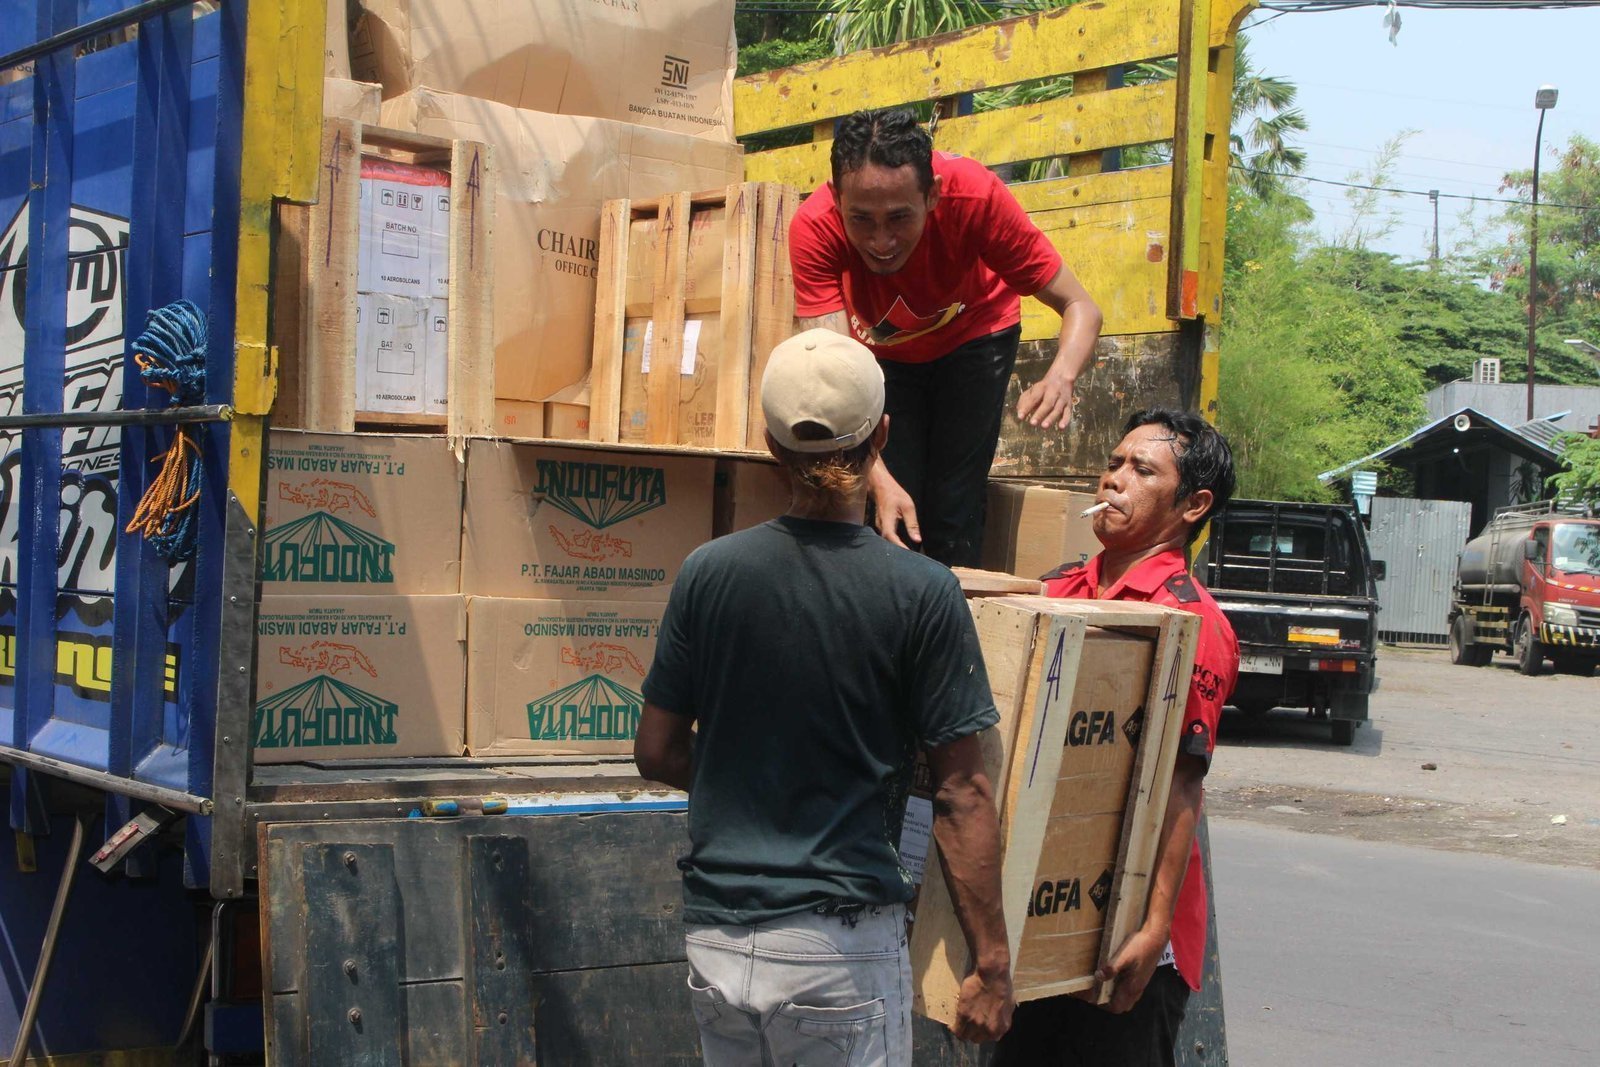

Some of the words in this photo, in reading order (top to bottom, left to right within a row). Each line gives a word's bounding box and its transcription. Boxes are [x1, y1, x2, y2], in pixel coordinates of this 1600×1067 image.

[661, 60, 690, 85] SNI
[628, 103, 657, 117] BANGGA
[657, 109, 687, 122] BUATAN
[385, 221, 406, 231] BATCH
[537, 228, 600, 262] CHAIR
[555, 259, 589, 278] OFFICE
[268, 455, 294, 470] MAS
[298, 457, 338, 472] ABADI
[341, 459, 380, 475] FAJAR
[384, 461, 405, 475] P.T.
[534, 459, 667, 504] INDOFUTA
[262, 543, 395, 583] INDOFUT
[521, 564, 541, 577] P.T.
[544, 565, 580, 578] FAJAR
[583, 566, 616, 580] ABADI
[618, 567, 666, 581] MASINDO
[258, 621, 295, 635] MASIN
[299, 621, 336, 635] ABADI
[341, 622, 381, 636] FAJAR
[385, 622, 406, 636] P.T.
[524, 623, 576, 637] MASINDO
[578, 624, 610, 637] ABADI
[615, 625, 648, 638] FAJAR
[526, 704, 642, 740] NDOFUTA
[1064, 710, 1115, 747] GFA
